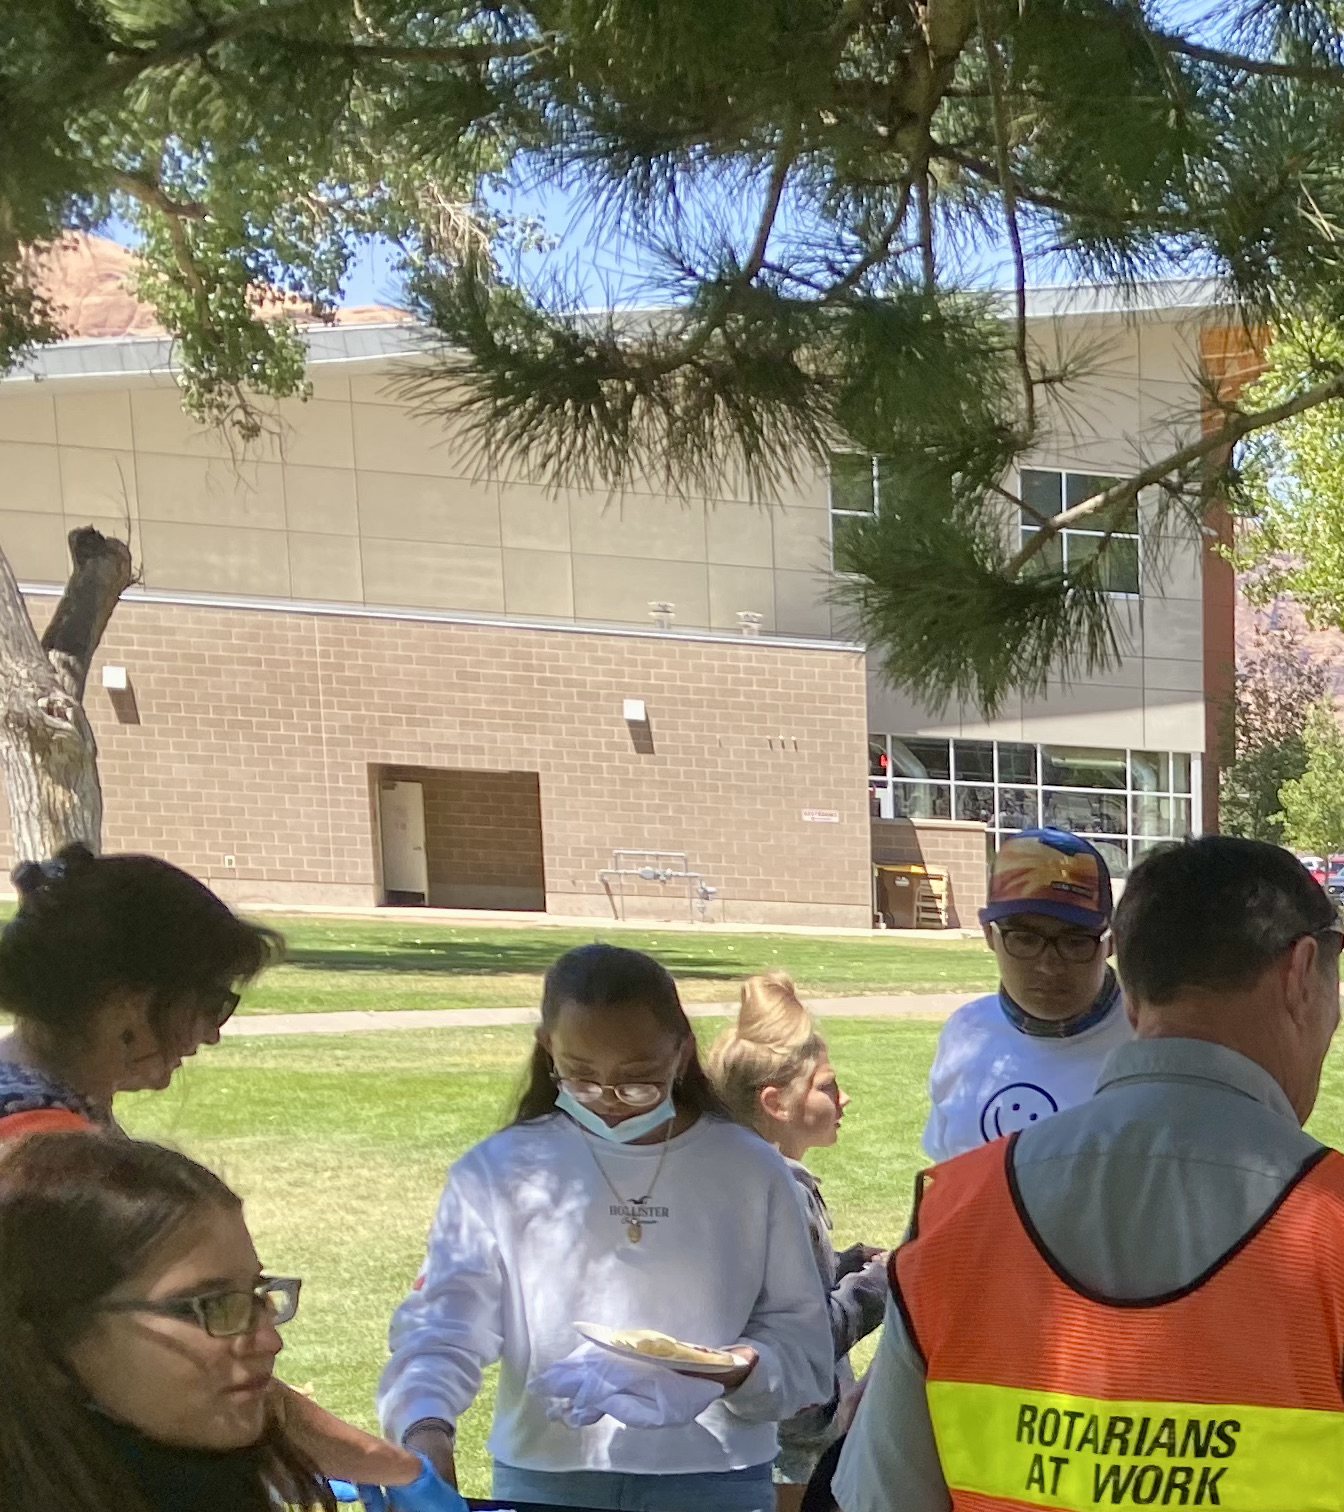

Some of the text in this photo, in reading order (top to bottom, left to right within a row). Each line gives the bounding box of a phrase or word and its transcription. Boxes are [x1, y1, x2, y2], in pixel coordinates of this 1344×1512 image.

[609, 1205, 669, 1218] HOLLISTER
[1016, 1403, 1241, 1459] ROTARIANS
[1025, 1453, 1228, 1506] AT WORK
